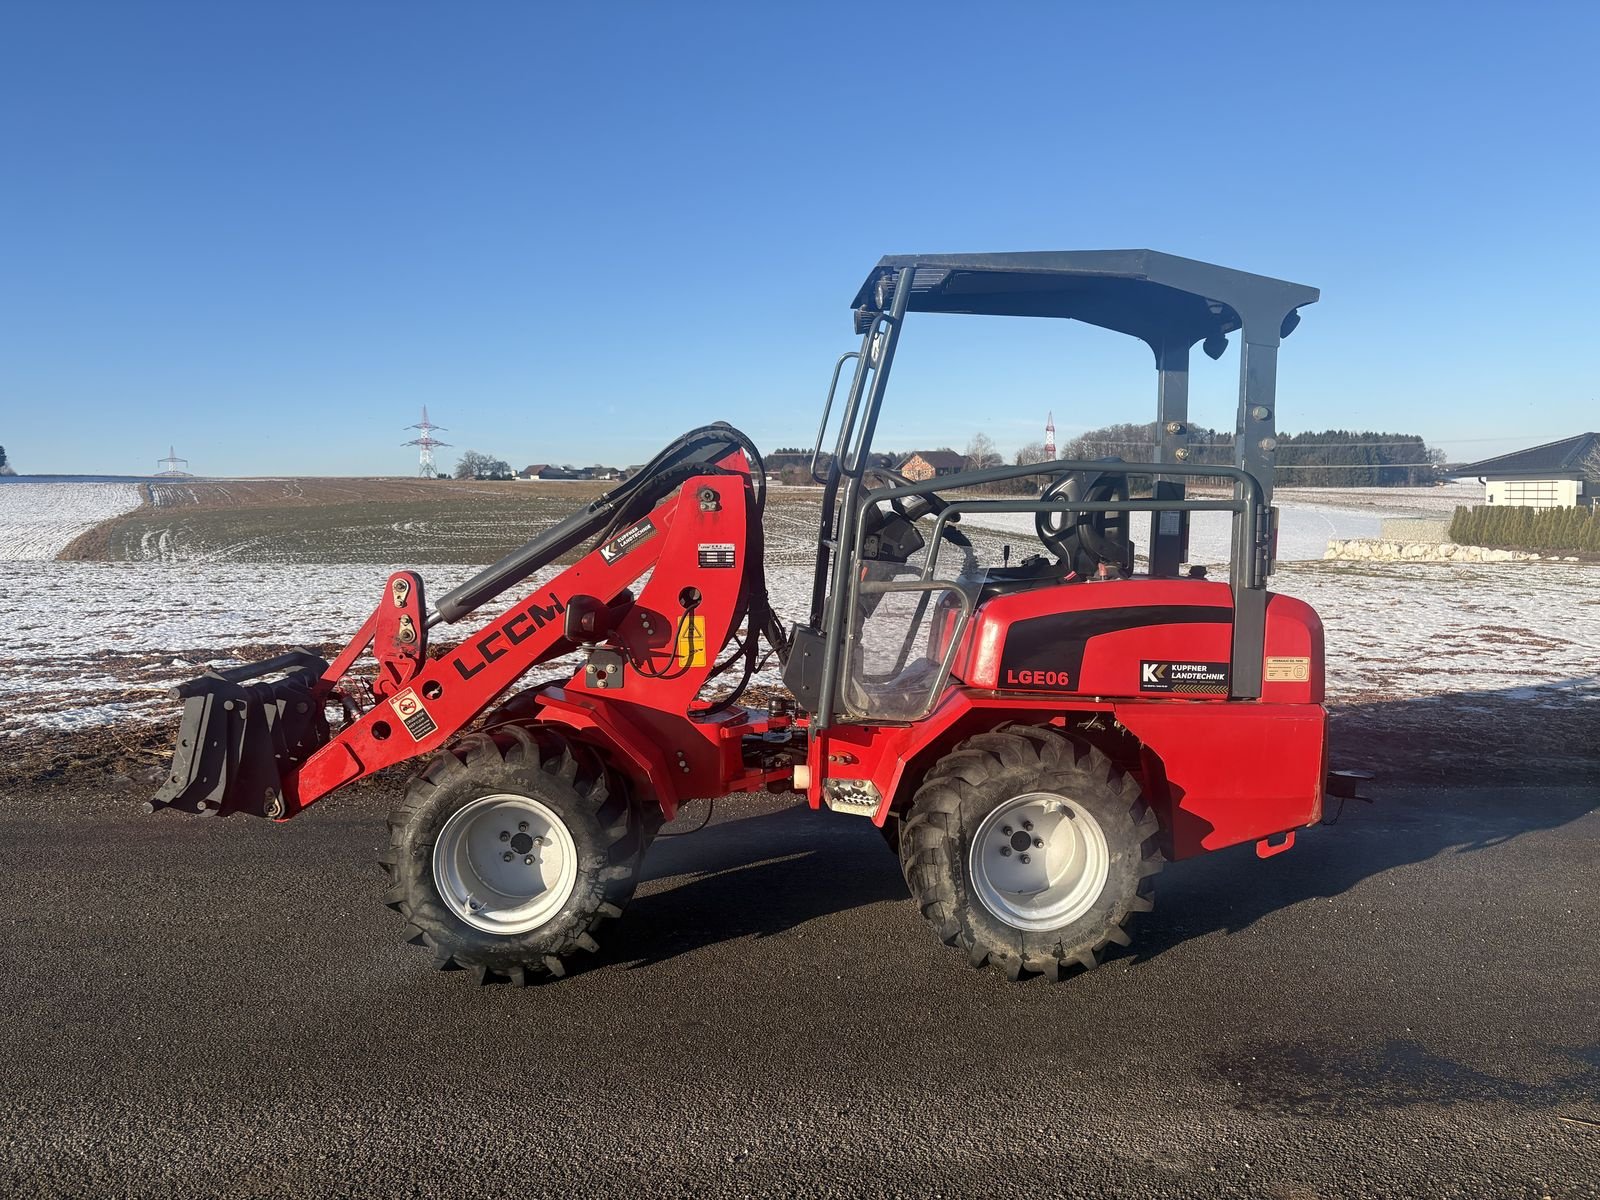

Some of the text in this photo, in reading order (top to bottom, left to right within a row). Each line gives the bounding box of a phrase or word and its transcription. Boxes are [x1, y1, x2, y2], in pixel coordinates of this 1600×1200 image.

[1171, 664, 1207, 672] KUPFNER
[1007, 670, 1069, 685] LGE06
[1171, 672, 1225, 680] LANDTECHNIK
